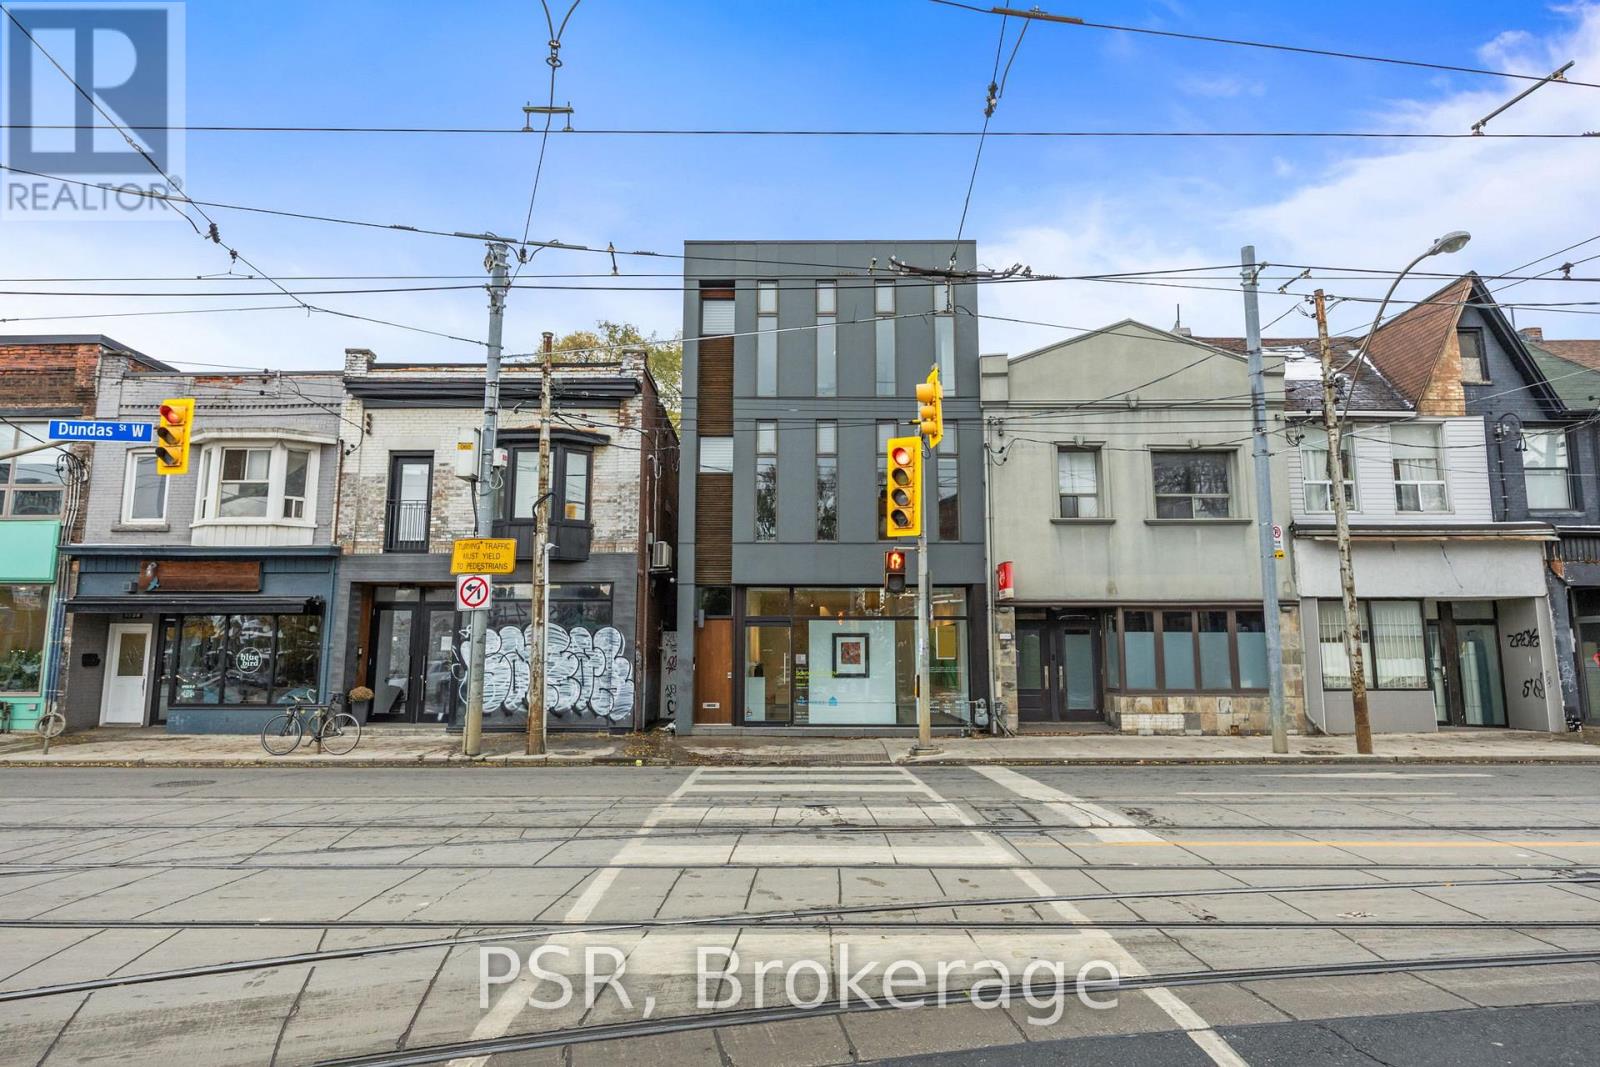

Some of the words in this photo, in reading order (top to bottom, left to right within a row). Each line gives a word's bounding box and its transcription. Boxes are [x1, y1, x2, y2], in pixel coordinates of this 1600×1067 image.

[58, 422, 113, 437] Dundas
[118, 424, 127, 432] St
[131, 424, 145, 437] W
[484, 542, 511, 551] TRAFFIC
[482, 552, 501, 560] YIELD
[466, 562, 508, 570] PEDESTRIANS
[240, 653, 259, 661] blue
[242, 659, 259, 667] bird
